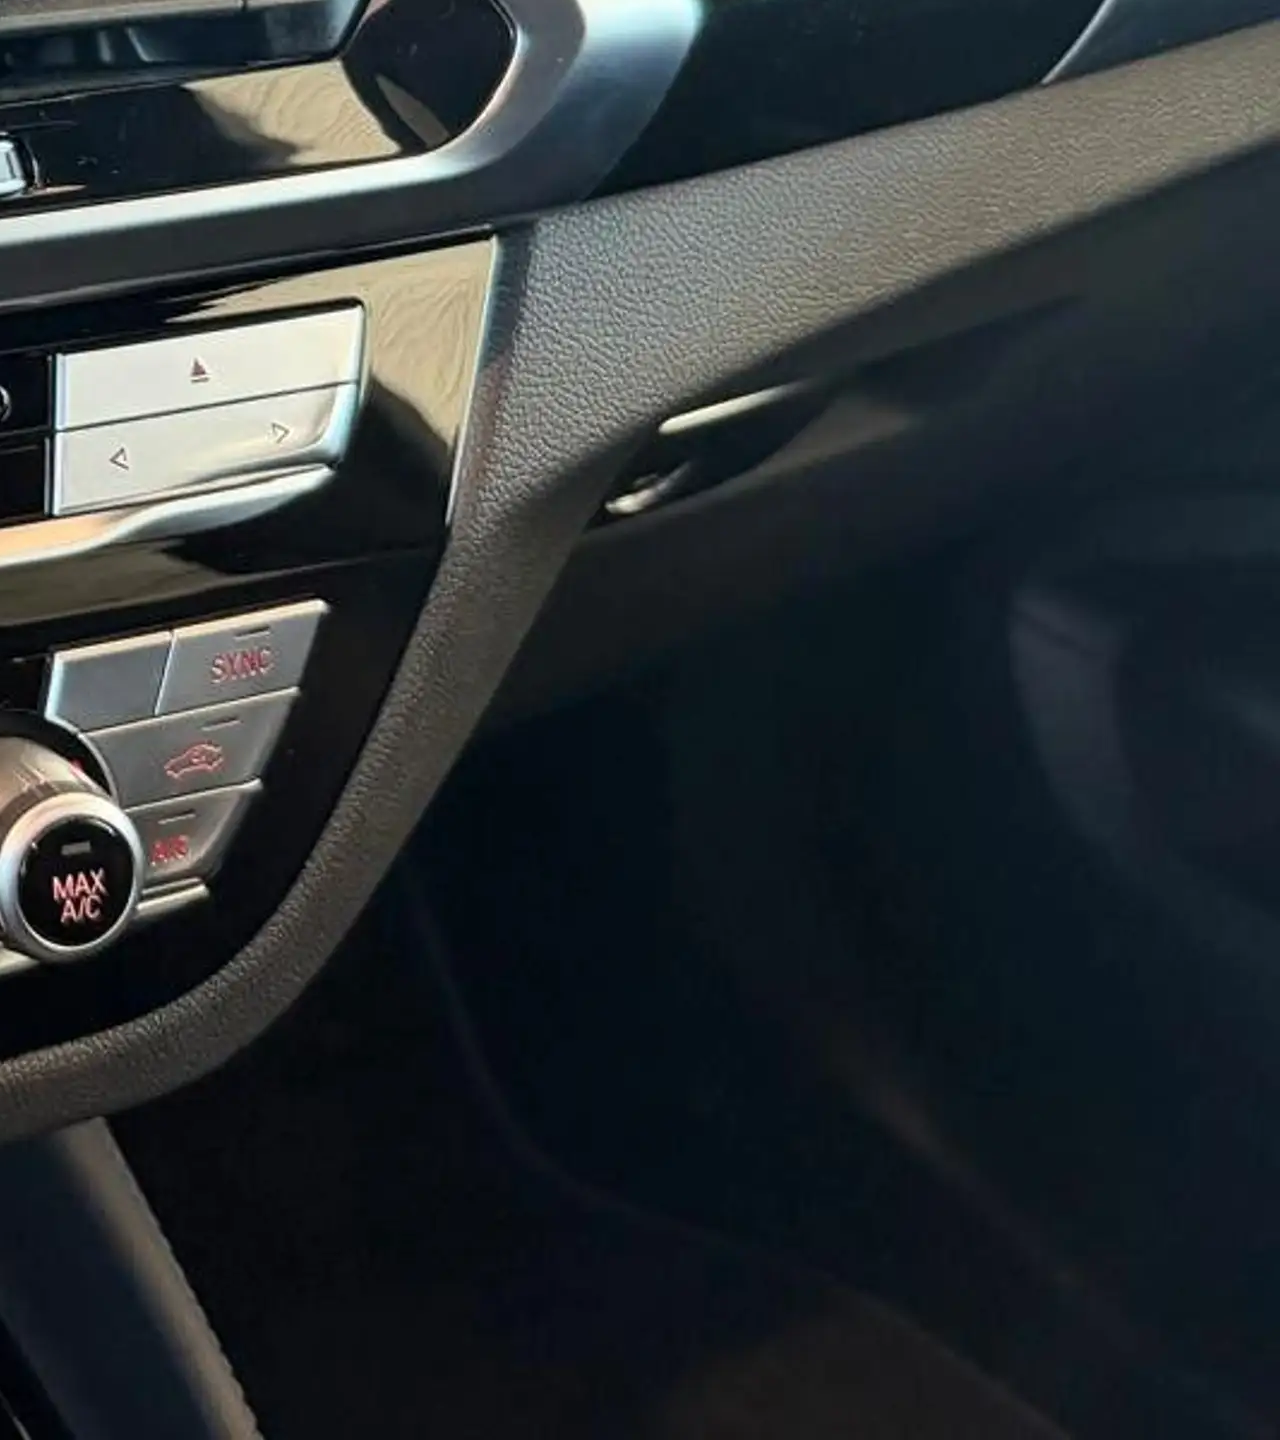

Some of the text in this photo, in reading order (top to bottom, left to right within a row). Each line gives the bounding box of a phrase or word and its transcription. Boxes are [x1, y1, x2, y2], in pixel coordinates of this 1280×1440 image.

[211, 646, 276, 684] SYNC
[52, 868, 109, 901] MAX
[60, 895, 101, 924] A/C
